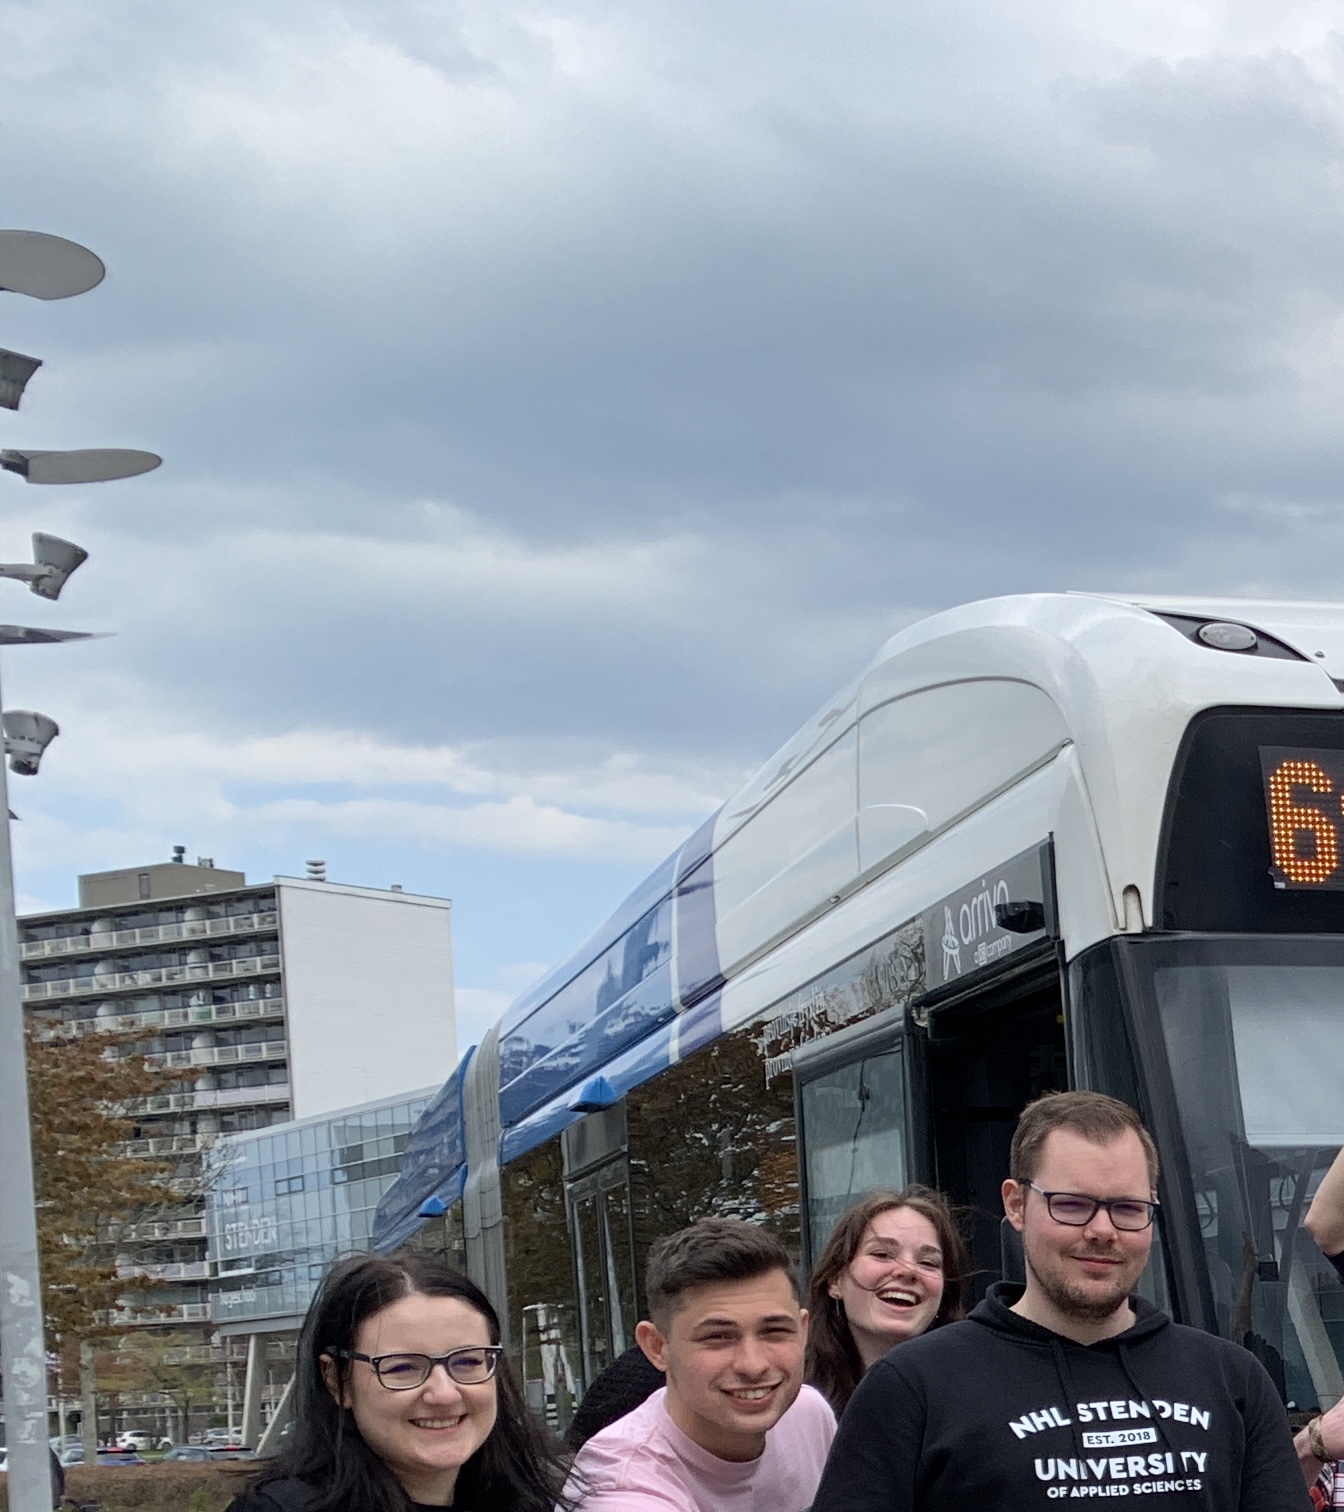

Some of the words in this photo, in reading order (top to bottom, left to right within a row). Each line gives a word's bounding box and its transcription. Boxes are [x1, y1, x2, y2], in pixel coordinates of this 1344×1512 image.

[1008, 1407, 1071, 1439] NHL
[1076, 1400, 1211, 1430] STENDEN
[1087, 1435, 1114, 1445] EST.
[1119, 1431, 1151, 1443] 2018
[1034, 1452, 1208, 1481] UNIVERSITY
[1047, 1486, 1069, 1498] OF
[1070, 1484, 1129, 1498] APPLIED
[1133, 1479, 1202, 1495] SCIENCES
